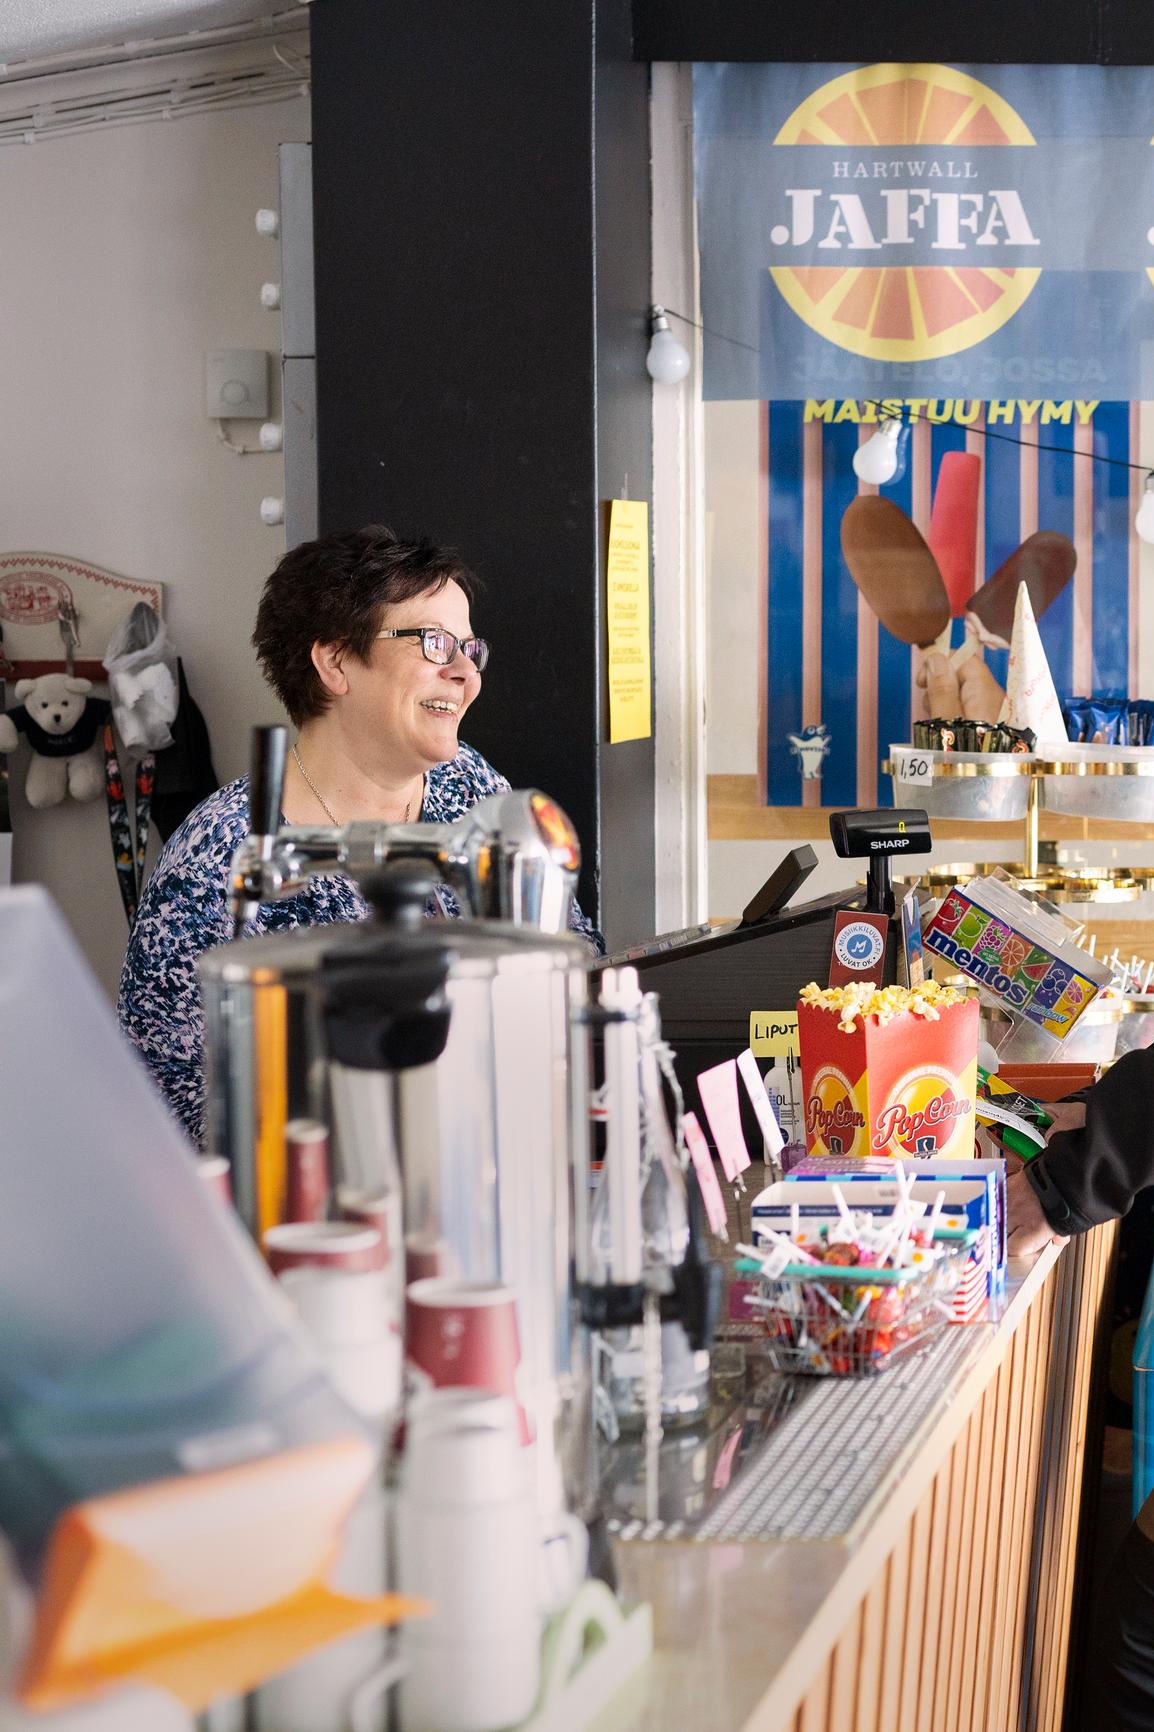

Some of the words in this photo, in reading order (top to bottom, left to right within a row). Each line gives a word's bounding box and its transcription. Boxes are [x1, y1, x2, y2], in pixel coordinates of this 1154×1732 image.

[833, 160, 978, 179] HARTWALL
[770, 187, 1041, 250] JAFFA
[803, 398, 984, 425] MAISTUU
[987, 398, 1101, 425] HYMY
[900, 758, 929, 779] 1,50
[870, 839, 910, 850] SHARP
[840, 953, 861, 968] LUVAT
[861, 958, 873, 967] OK
[925, 926, 1030, 1006] mentos
[1026, 1002, 1070, 1024] rainbow
[754, 1023, 798, 1040] LIPUT
[806, 1095, 866, 1136] PopCorn
[872, 1096, 972, 1150] PopCorn
